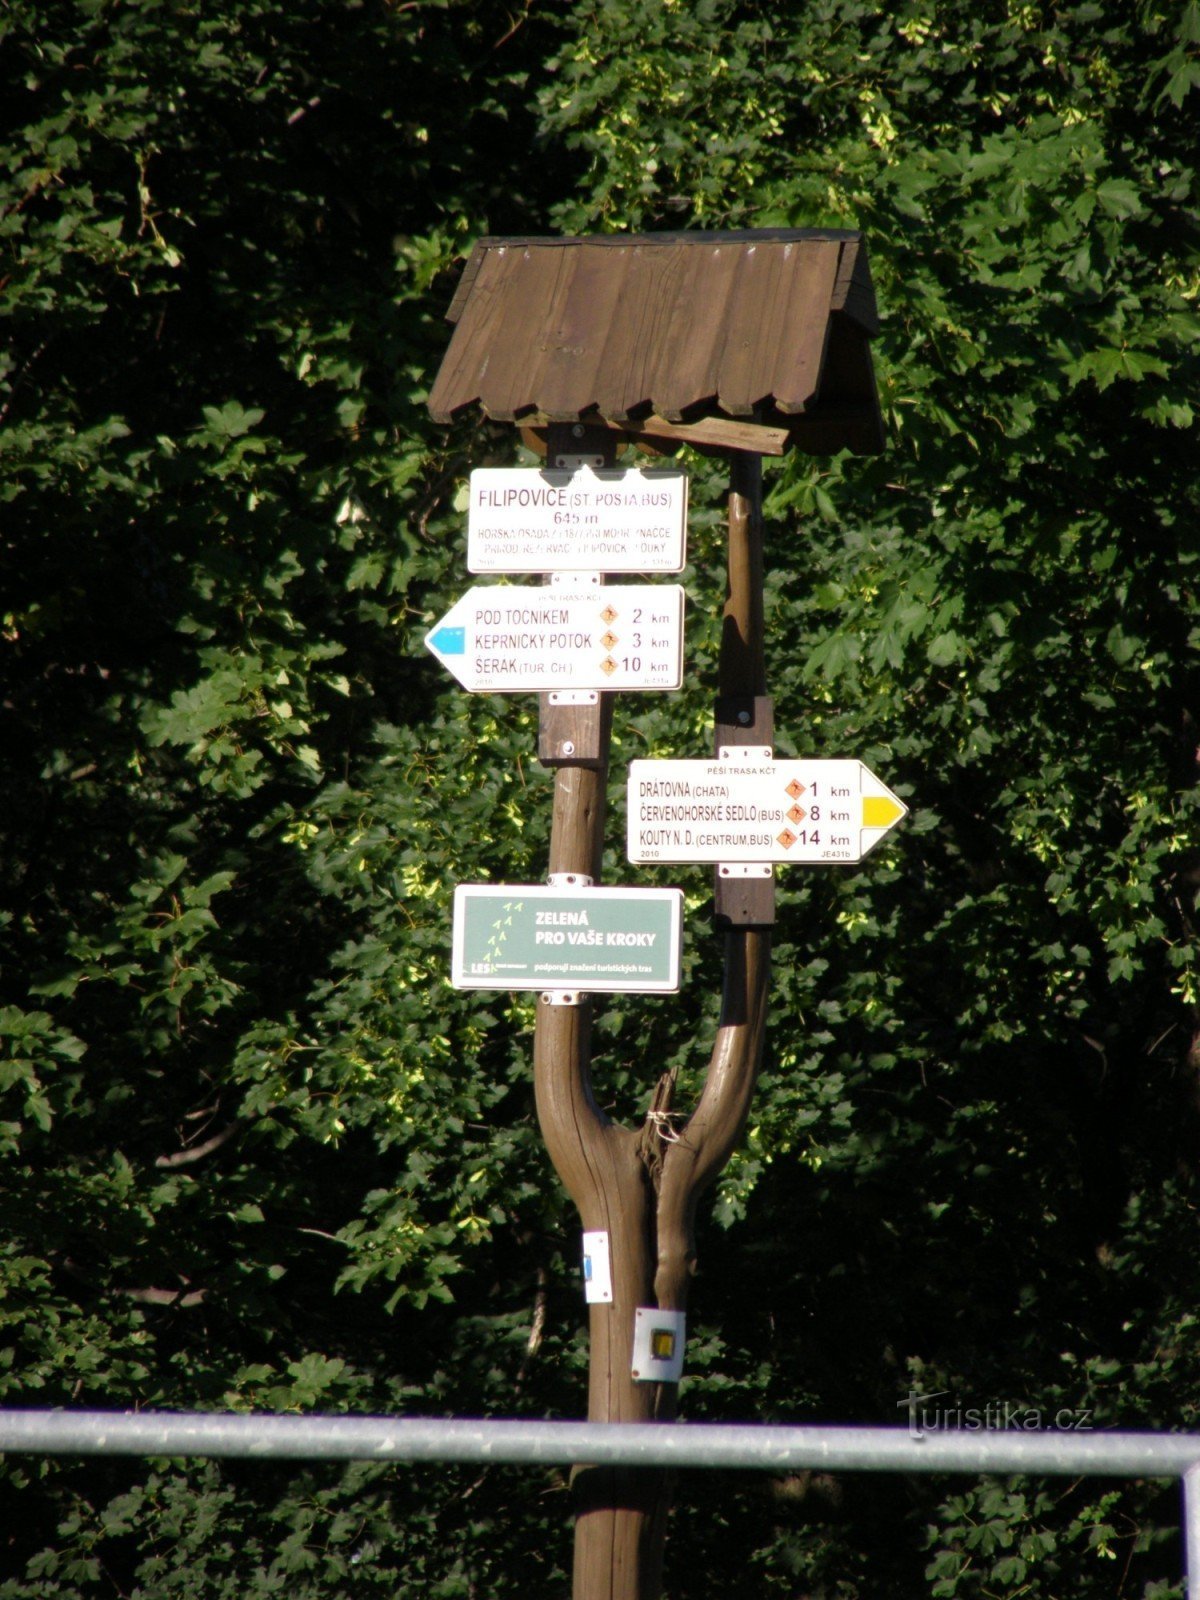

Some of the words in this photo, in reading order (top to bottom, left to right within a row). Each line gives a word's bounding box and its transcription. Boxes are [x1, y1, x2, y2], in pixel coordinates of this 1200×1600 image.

[479, 489, 568, 507] FILIPOVICE
[553, 511, 580, 525] 645
[585, 513, 598, 524] m
[475, 610, 501, 625] POD
[632, 608, 642, 624] 2
[651, 613, 670, 624] km
[549, 633, 592, 649] POTOK
[632, 632, 642, 649] 3
[651, 637, 669, 648] km
[622, 657, 641, 672] 10
[651, 661, 668, 672] km
[707, 766, 727, 775] PĚŠÍ
[729, 767, 757, 775] TRASA
[759, 766, 776, 775] KČT
[640, 778, 691, 798] DRÁTOVNA
[692, 786, 730, 799] (CHATA)
[810, 781, 818, 797] 1
[831, 786, 850, 797] km
[640, 802, 723, 821] ČERVENOHORSKÉ
[726, 805, 757, 821] SEDLO
[758, 810, 784, 823] (BUS)
[810, 806, 821, 821] 8
[830, 810, 850, 821] km
[640, 829, 670, 846] KOUTY
[799, 830, 821, 846] 14
[830, 835, 850, 846] km
[536, 910, 589, 926] ZELENÁ
[535, 931, 565, 945] PRO
[567, 929, 603, 946] VAŠE
[607, 932, 657, 947] KROKY
[569, 963, 596, 972] značení
[597, 963, 637, 974] turistických
